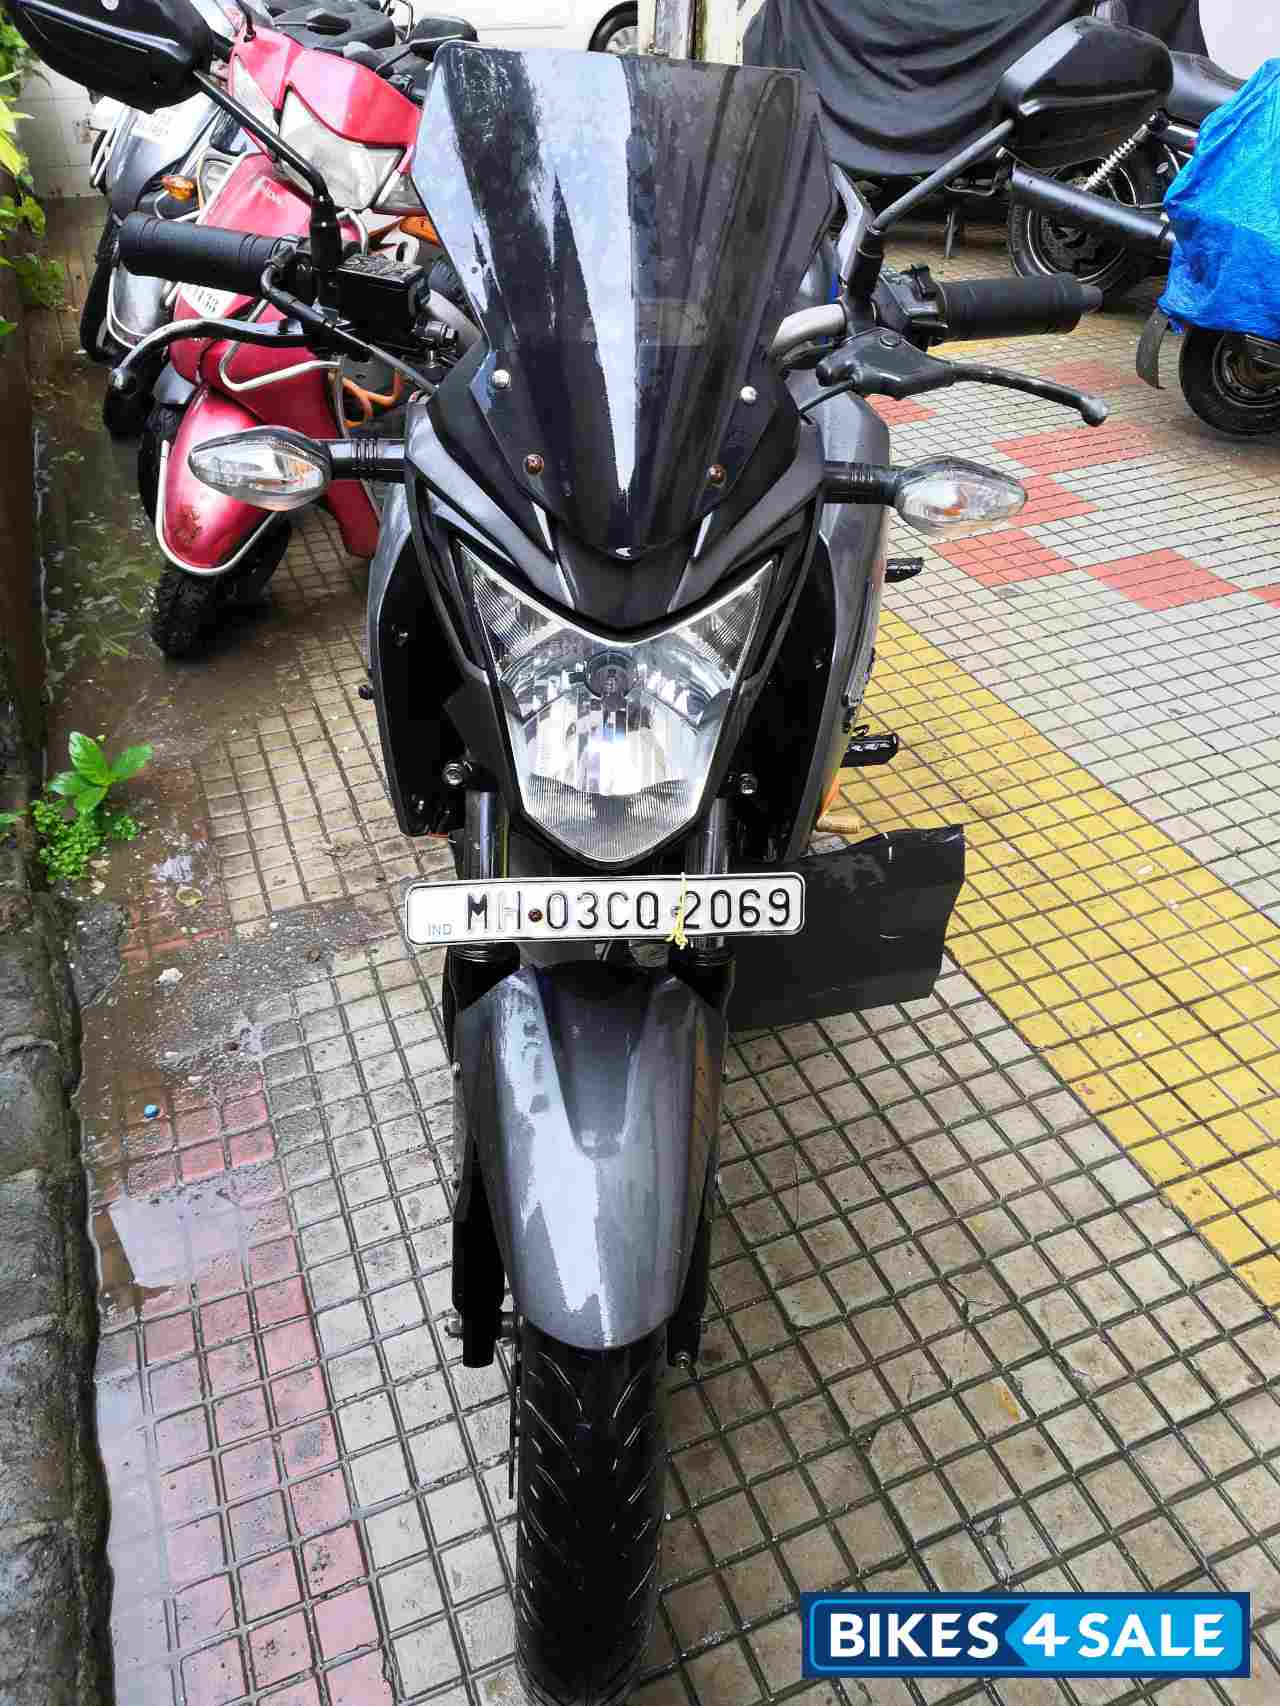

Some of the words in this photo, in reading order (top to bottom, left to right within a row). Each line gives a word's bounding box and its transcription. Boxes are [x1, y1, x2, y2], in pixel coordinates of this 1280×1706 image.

[466, 891, 522, 932] MH
[681, 887, 790, 931] 2069
[427, 923, 452, 937] IND
